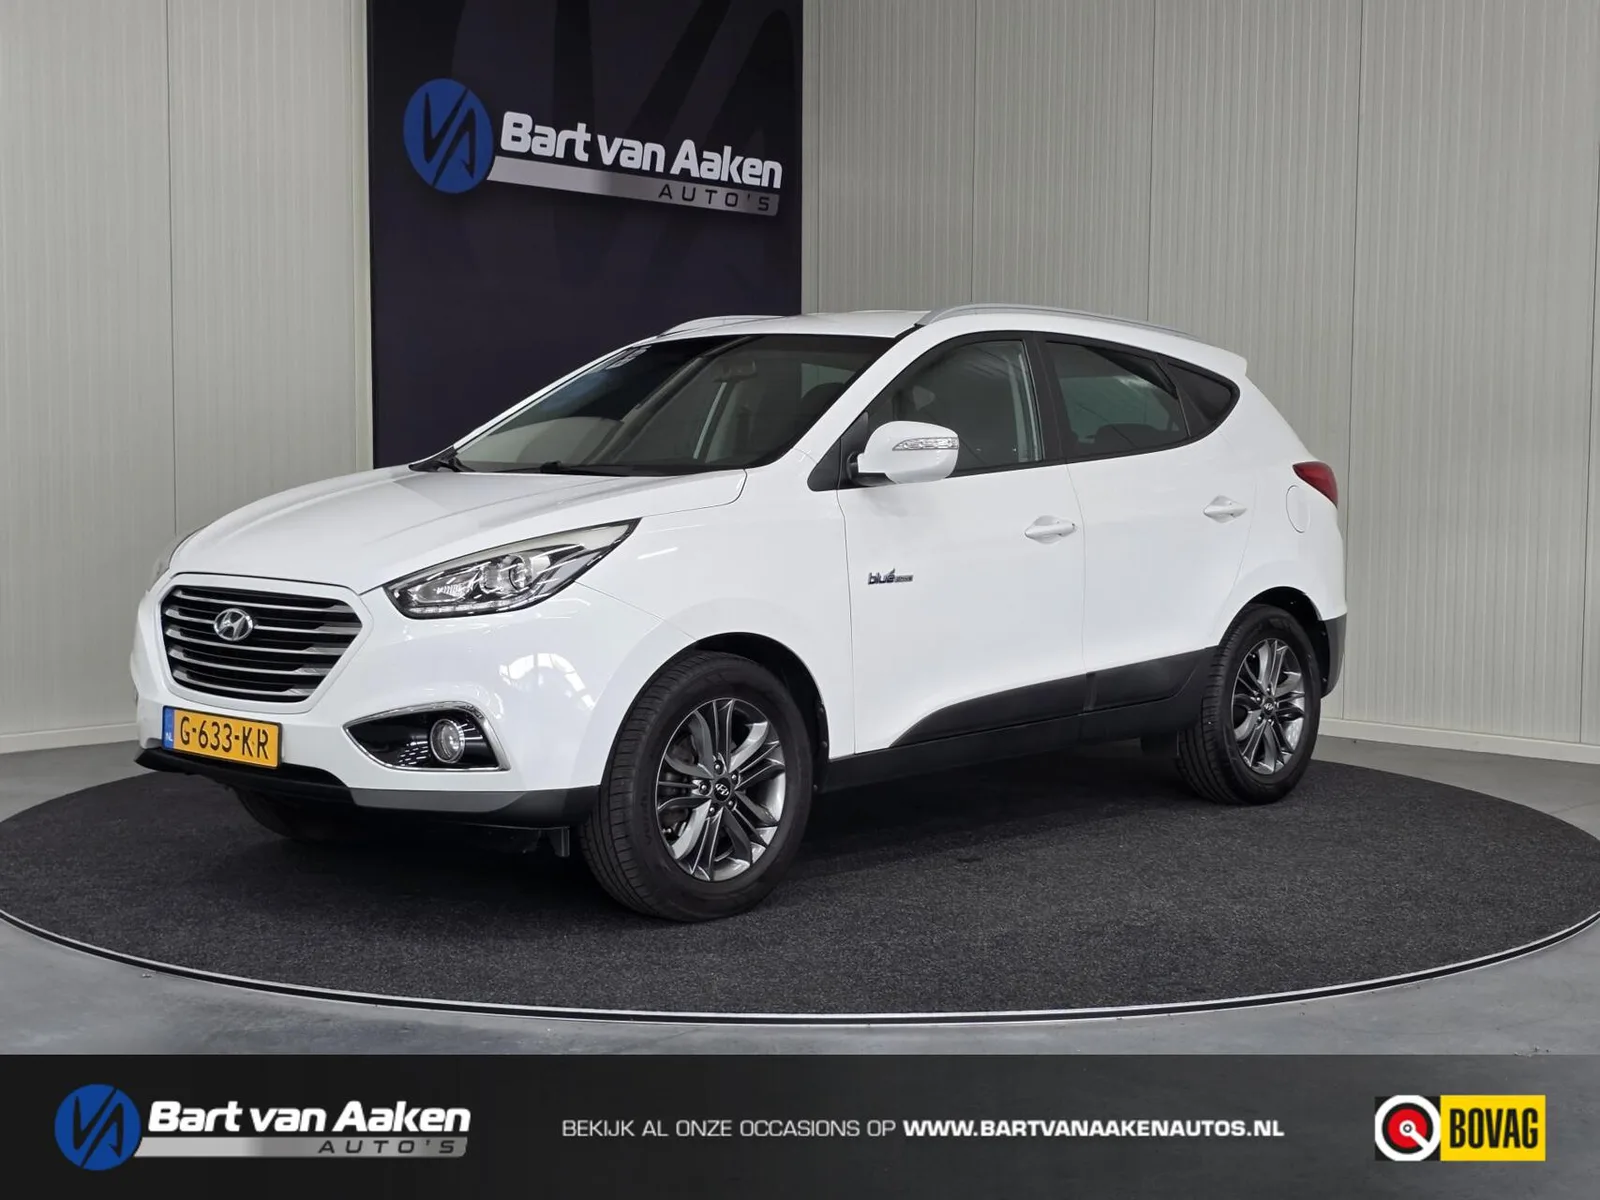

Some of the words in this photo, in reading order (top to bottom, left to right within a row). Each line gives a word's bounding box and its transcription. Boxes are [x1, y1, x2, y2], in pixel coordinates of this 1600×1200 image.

[500, 110, 592, 163] Bart
[598, 133, 666, 173] van
[670, 138, 784, 189] Aaken
[657, 183, 771, 213] AUTO'S
[180, 715, 269, 760] G-633-KR
